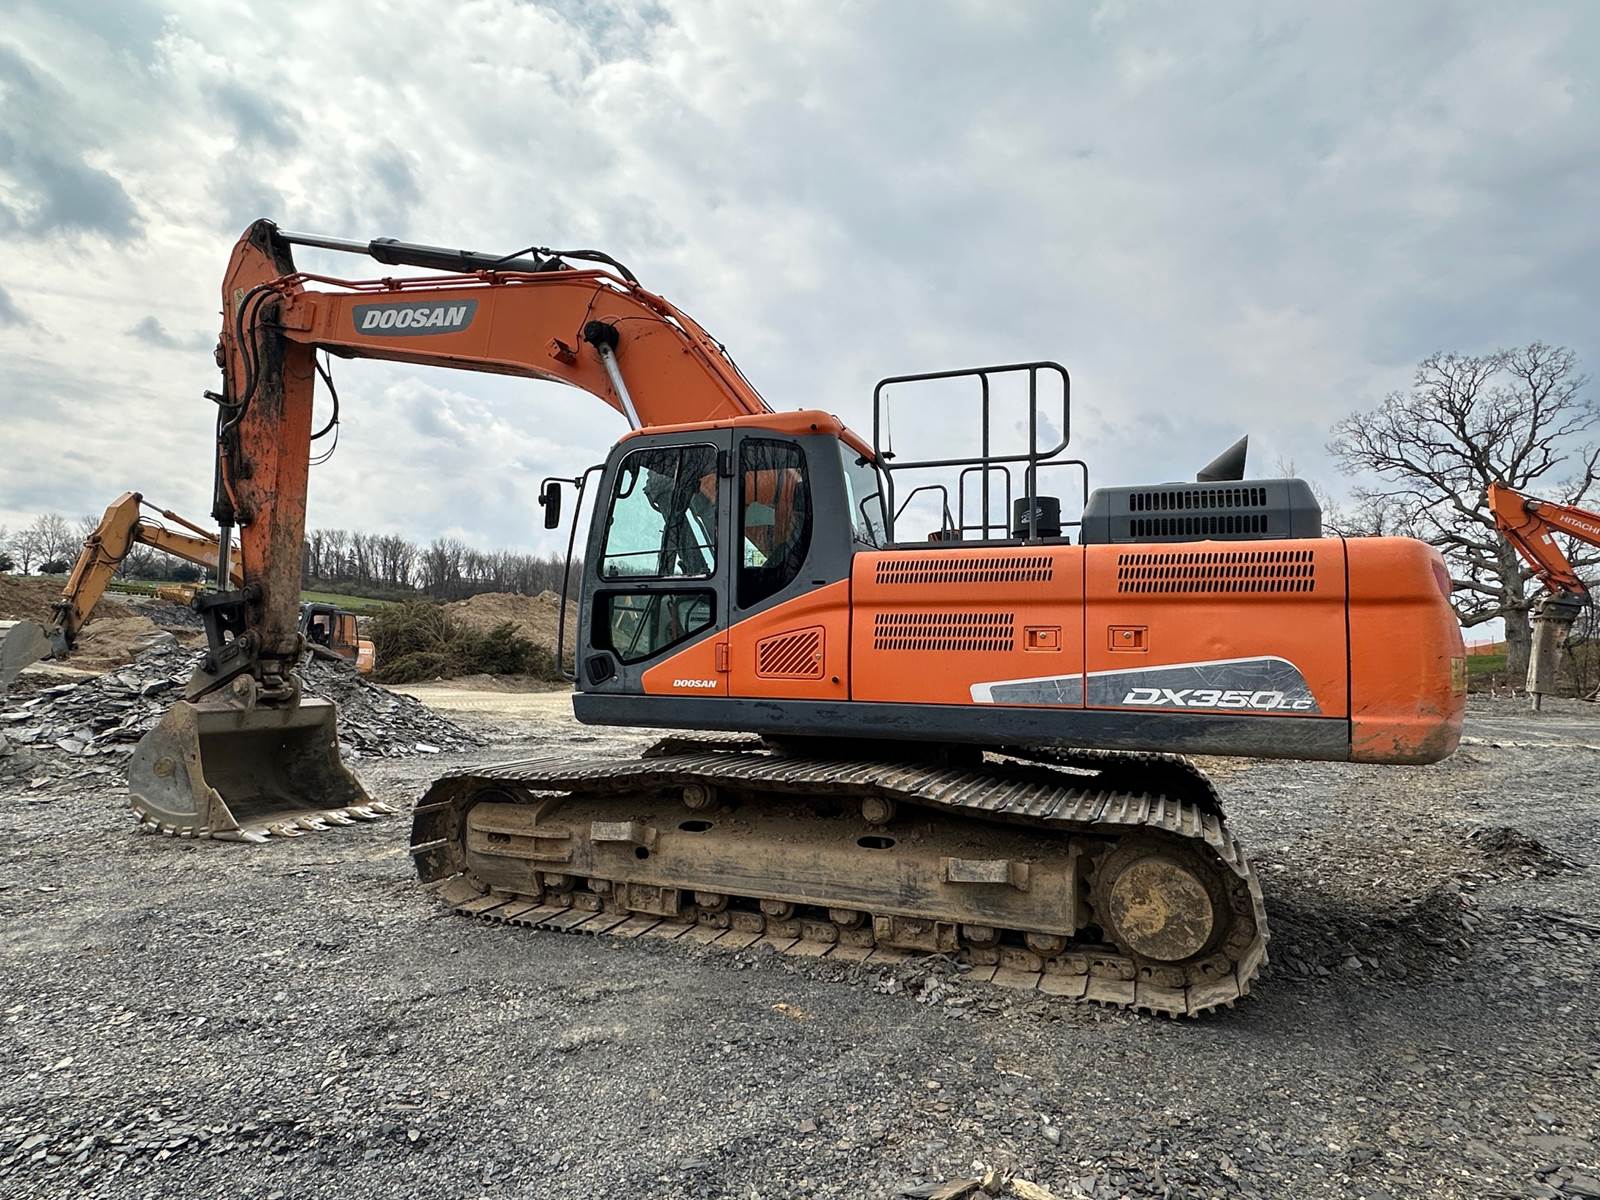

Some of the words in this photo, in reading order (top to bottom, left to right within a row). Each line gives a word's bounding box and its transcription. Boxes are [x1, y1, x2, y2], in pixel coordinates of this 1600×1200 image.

[361, 306, 467, 329] DOOSAN
[1560, 514, 1600, 535] HITACHI
[672, 679, 717, 688] DOOSAN
